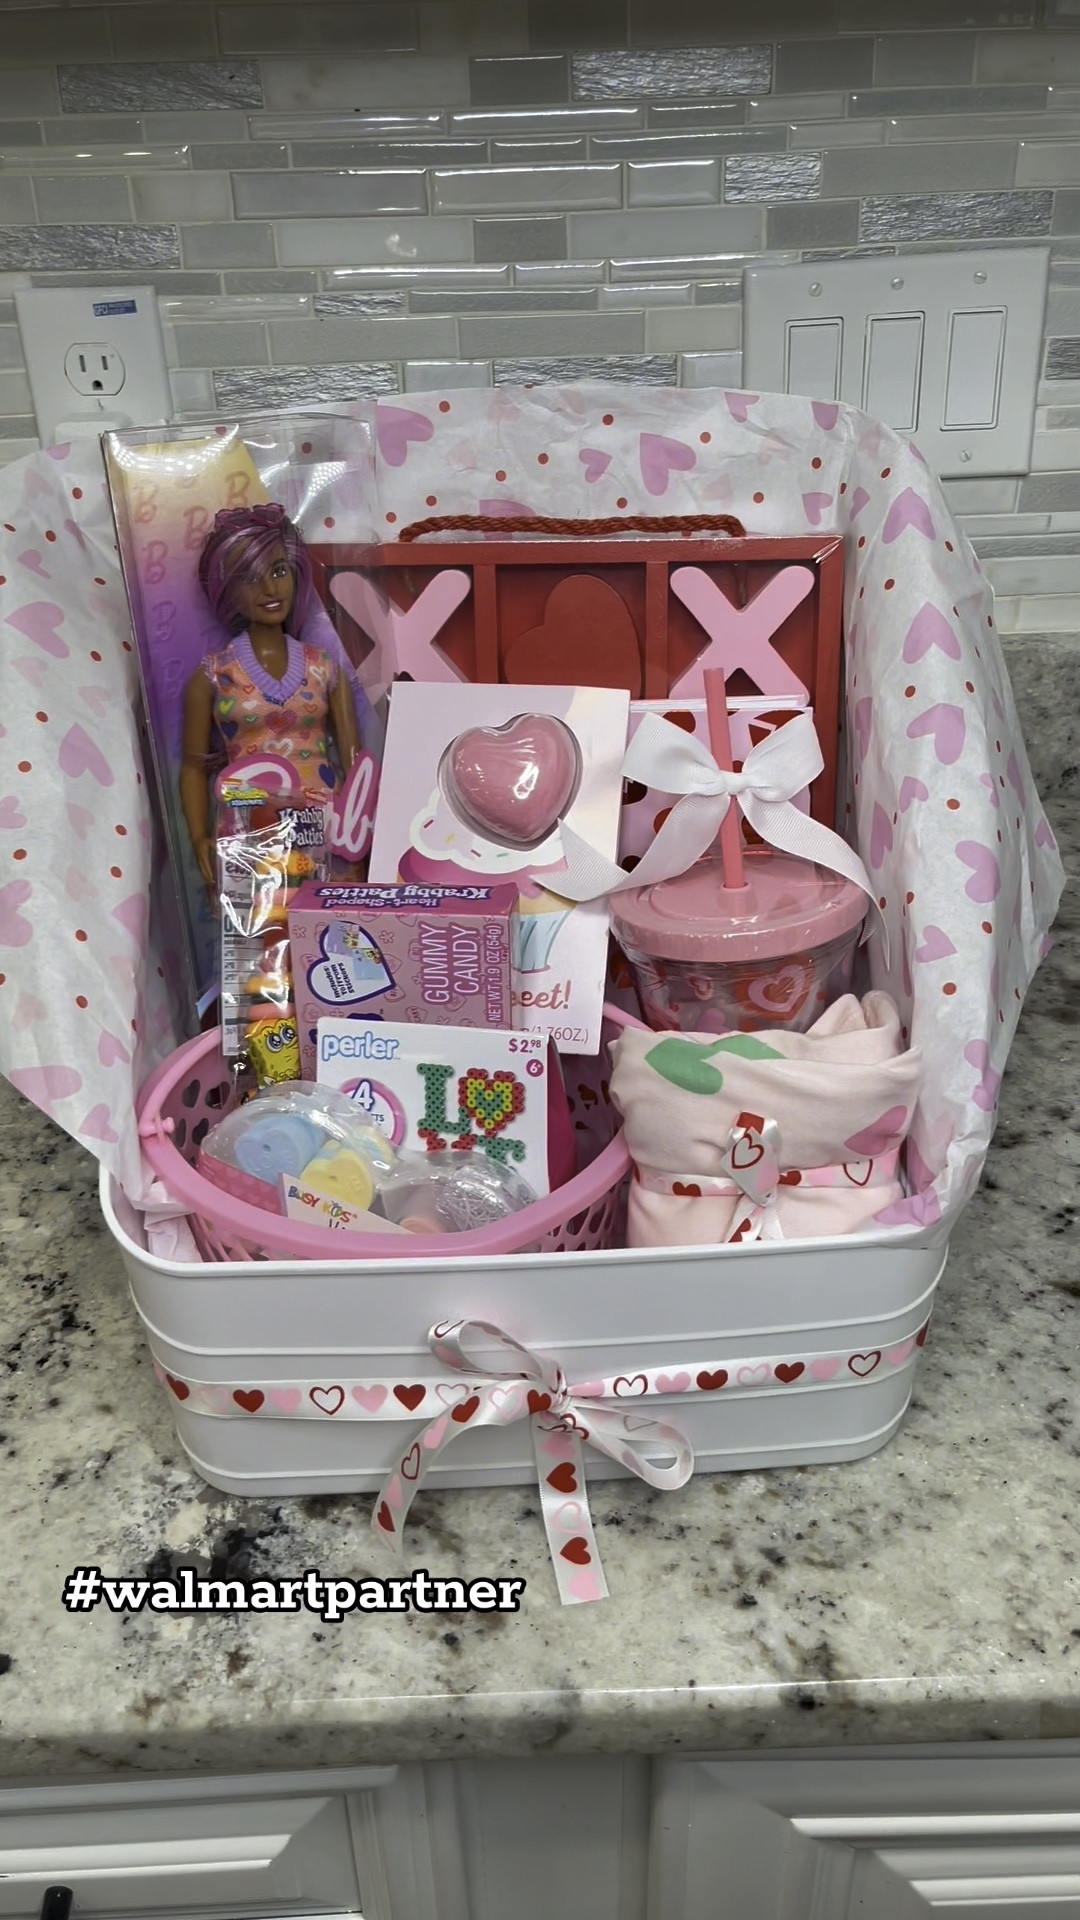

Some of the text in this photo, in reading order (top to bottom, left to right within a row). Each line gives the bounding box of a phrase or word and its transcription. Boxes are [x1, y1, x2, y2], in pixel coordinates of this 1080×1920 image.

[279, 808, 324, 828] Krabby
[319, 885, 491, 900] Krabby Patties
[325, 897, 438, 908] Heart-Shaped
[420, 923, 450, 1004] GUMMY
[451, 924, 480, 995] CANDY
[486, 967, 501, 982] 1.9
[487, 984, 501, 1001] WT
[487, 1003, 502, 1022] NET
[321, 1031, 400, 1061] perler
[508, 1037, 542, 1054] $2.98
[351, 1079, 376, 1112] 4
